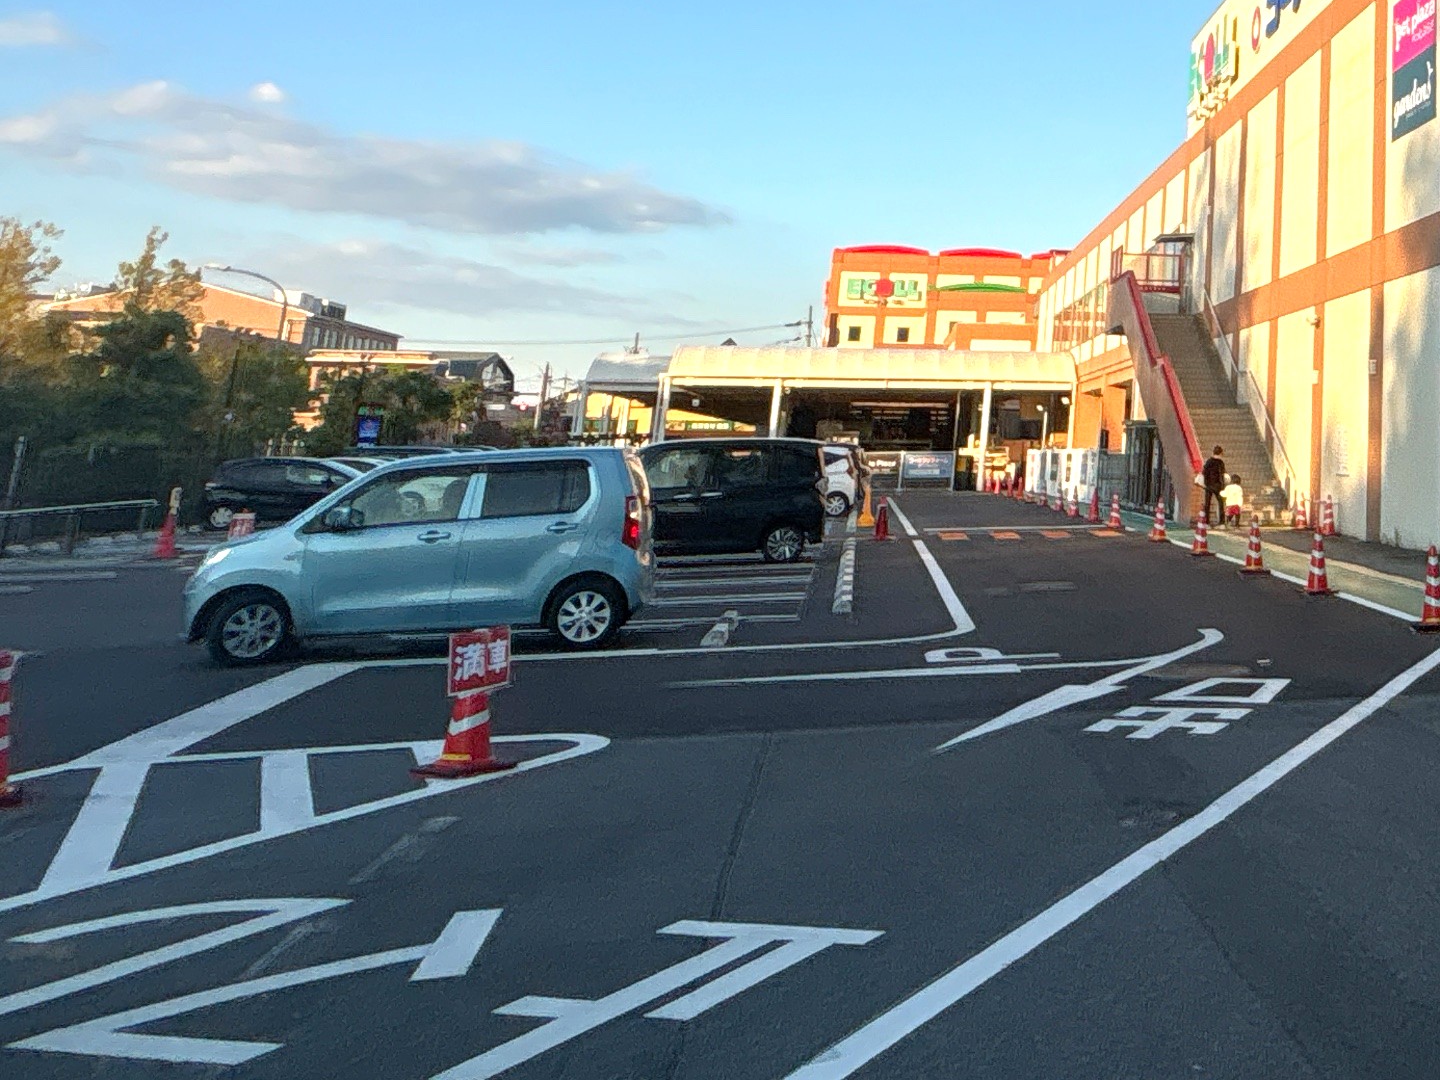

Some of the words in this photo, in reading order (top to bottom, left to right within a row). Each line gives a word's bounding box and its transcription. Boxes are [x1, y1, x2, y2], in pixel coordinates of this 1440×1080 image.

[1411, 0, 1436, 35] plaza
[453, 638, 507, 681] 満車
[1082, 677, 1292, 739] 出口
